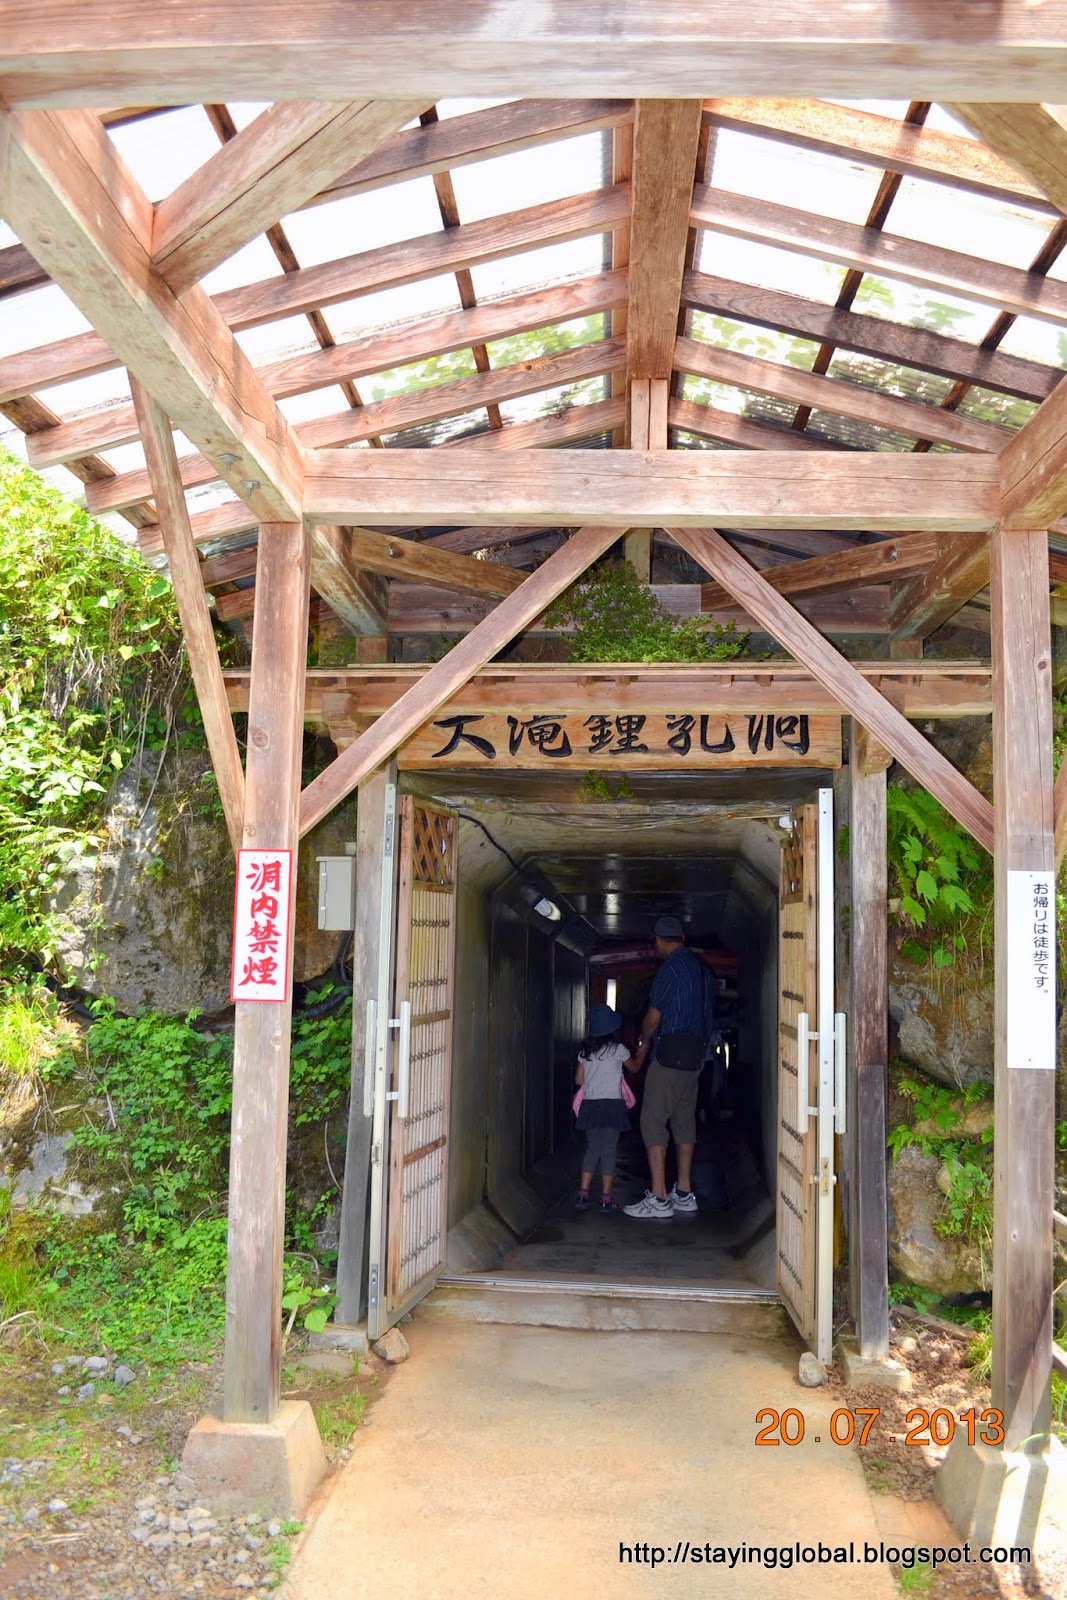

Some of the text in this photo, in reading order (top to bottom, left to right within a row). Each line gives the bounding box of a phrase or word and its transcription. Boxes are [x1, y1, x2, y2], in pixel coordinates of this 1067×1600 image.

[238, 860, 282, 987] 洞内禁煙
[1033, 883, 1049, 994] お帰りは徒歩です。
